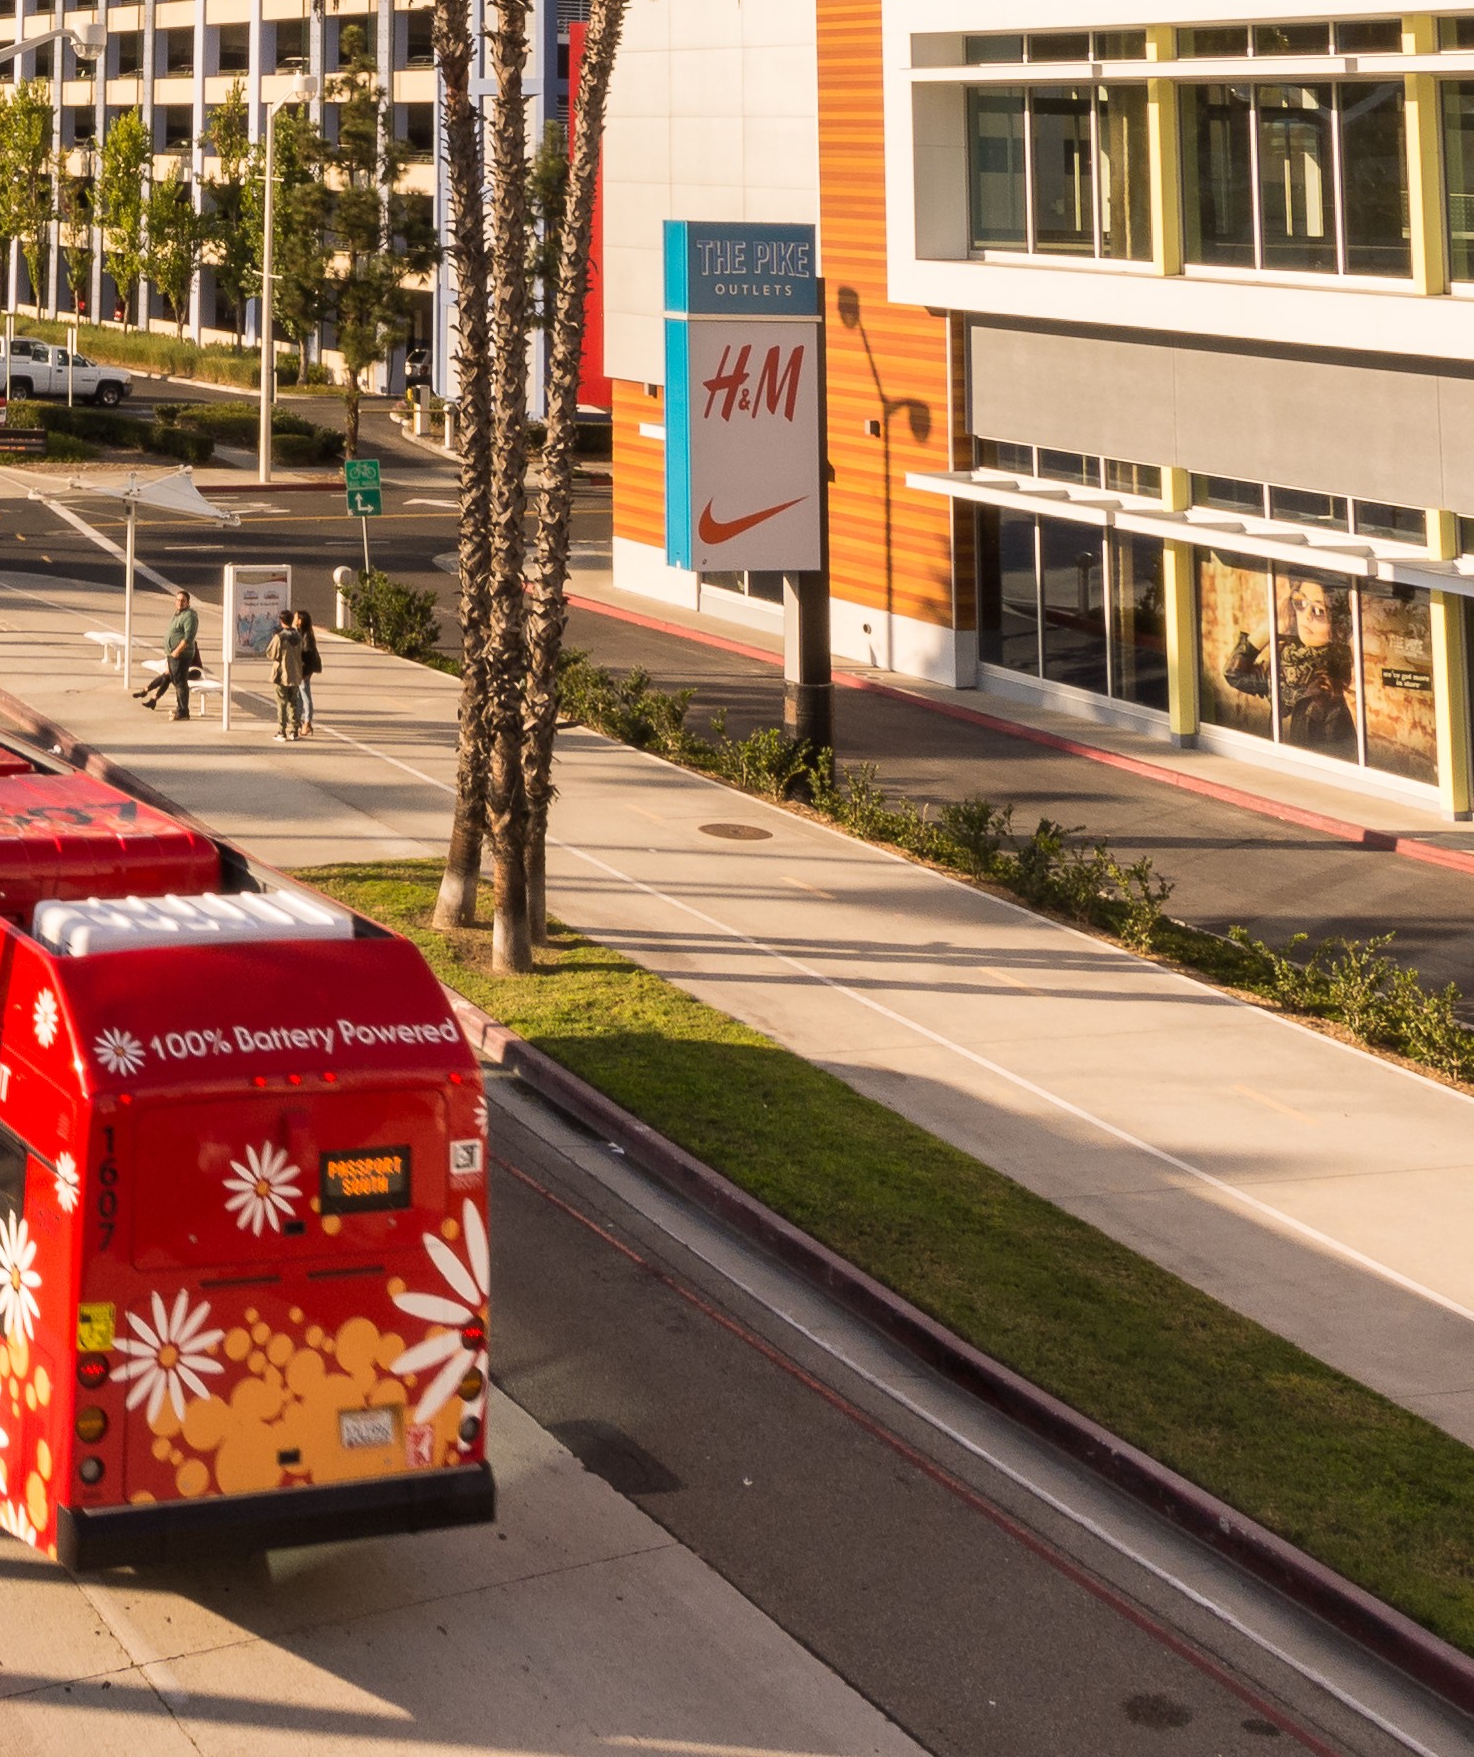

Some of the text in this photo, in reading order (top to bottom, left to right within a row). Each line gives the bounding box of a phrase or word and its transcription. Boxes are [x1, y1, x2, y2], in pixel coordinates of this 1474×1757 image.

[696, 239, 809, 277] THE PIKE
[714, 283, 792, 296] OUTLETS
[703, 344, 804, 422] H&M
[151, 1018, 460, 1060] 100% Battery Powered
